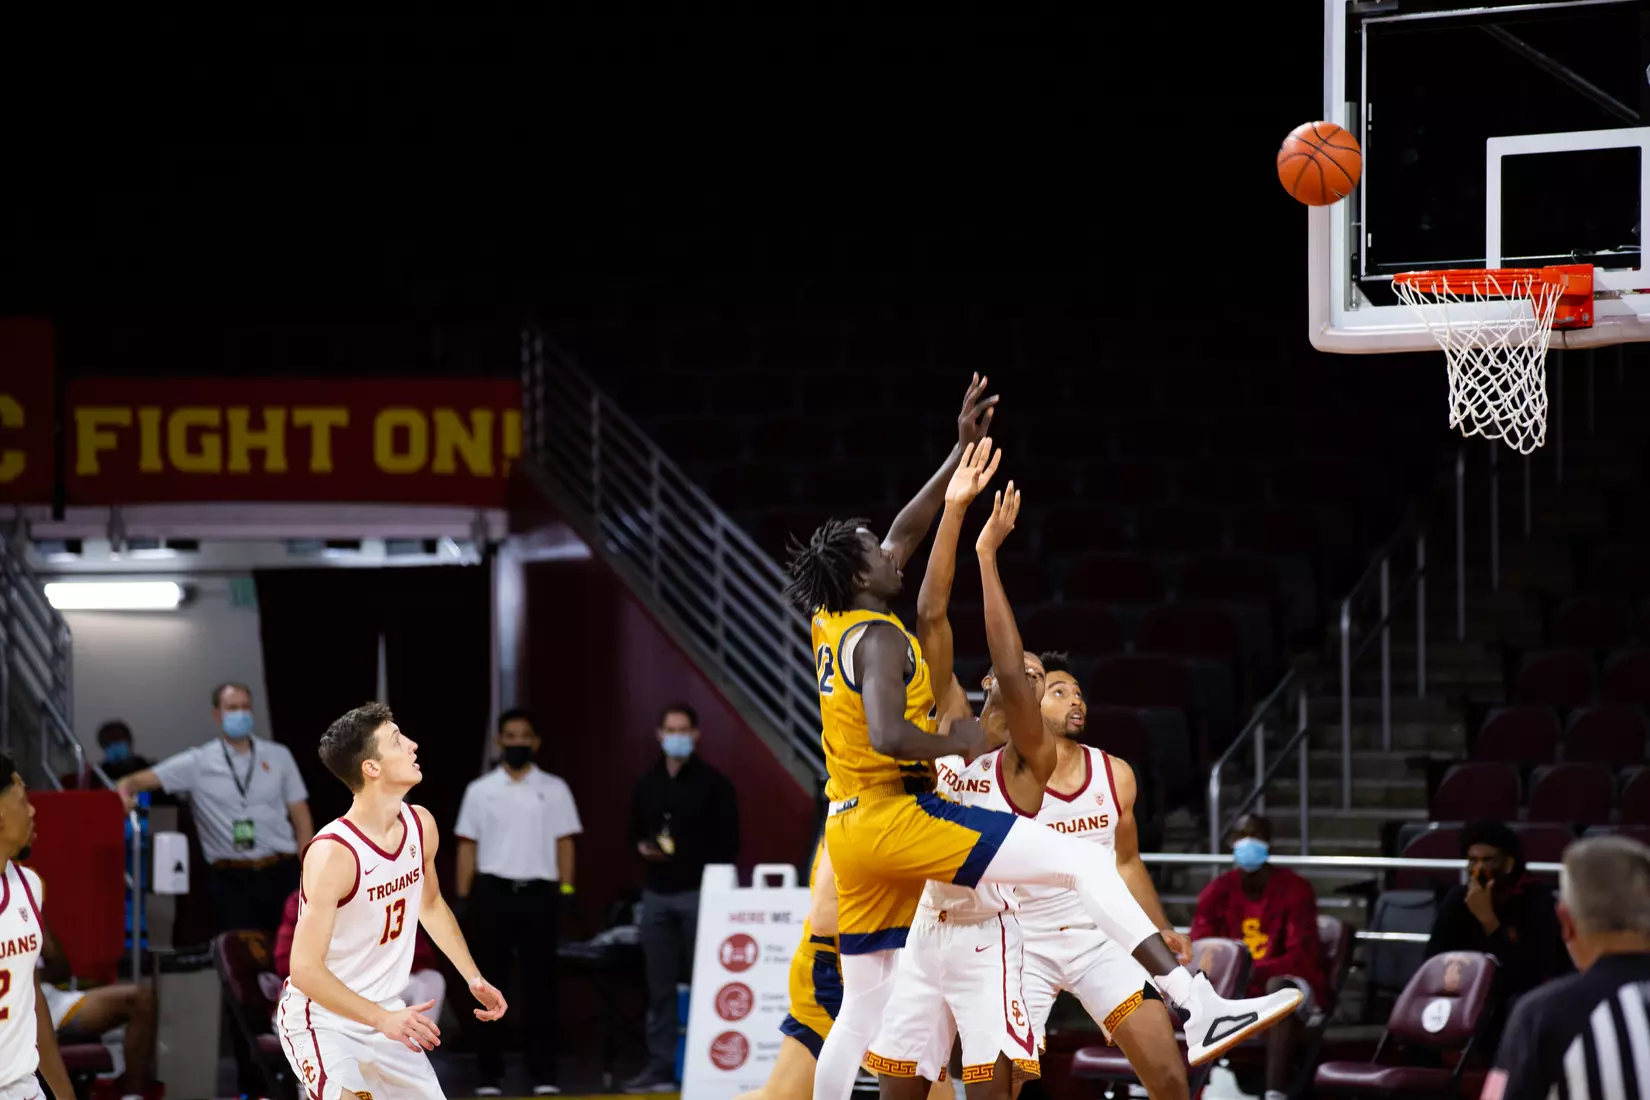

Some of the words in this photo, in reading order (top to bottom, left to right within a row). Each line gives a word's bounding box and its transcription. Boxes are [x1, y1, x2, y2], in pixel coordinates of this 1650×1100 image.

[74, 406, 350, 476] FIGHT
[372, 407, 522, 477] ON!
[1046, 814, 1109, 834] OJANS
[366, 867, 420, 901] TROJANS
[379, 897, 406, 946] 13
